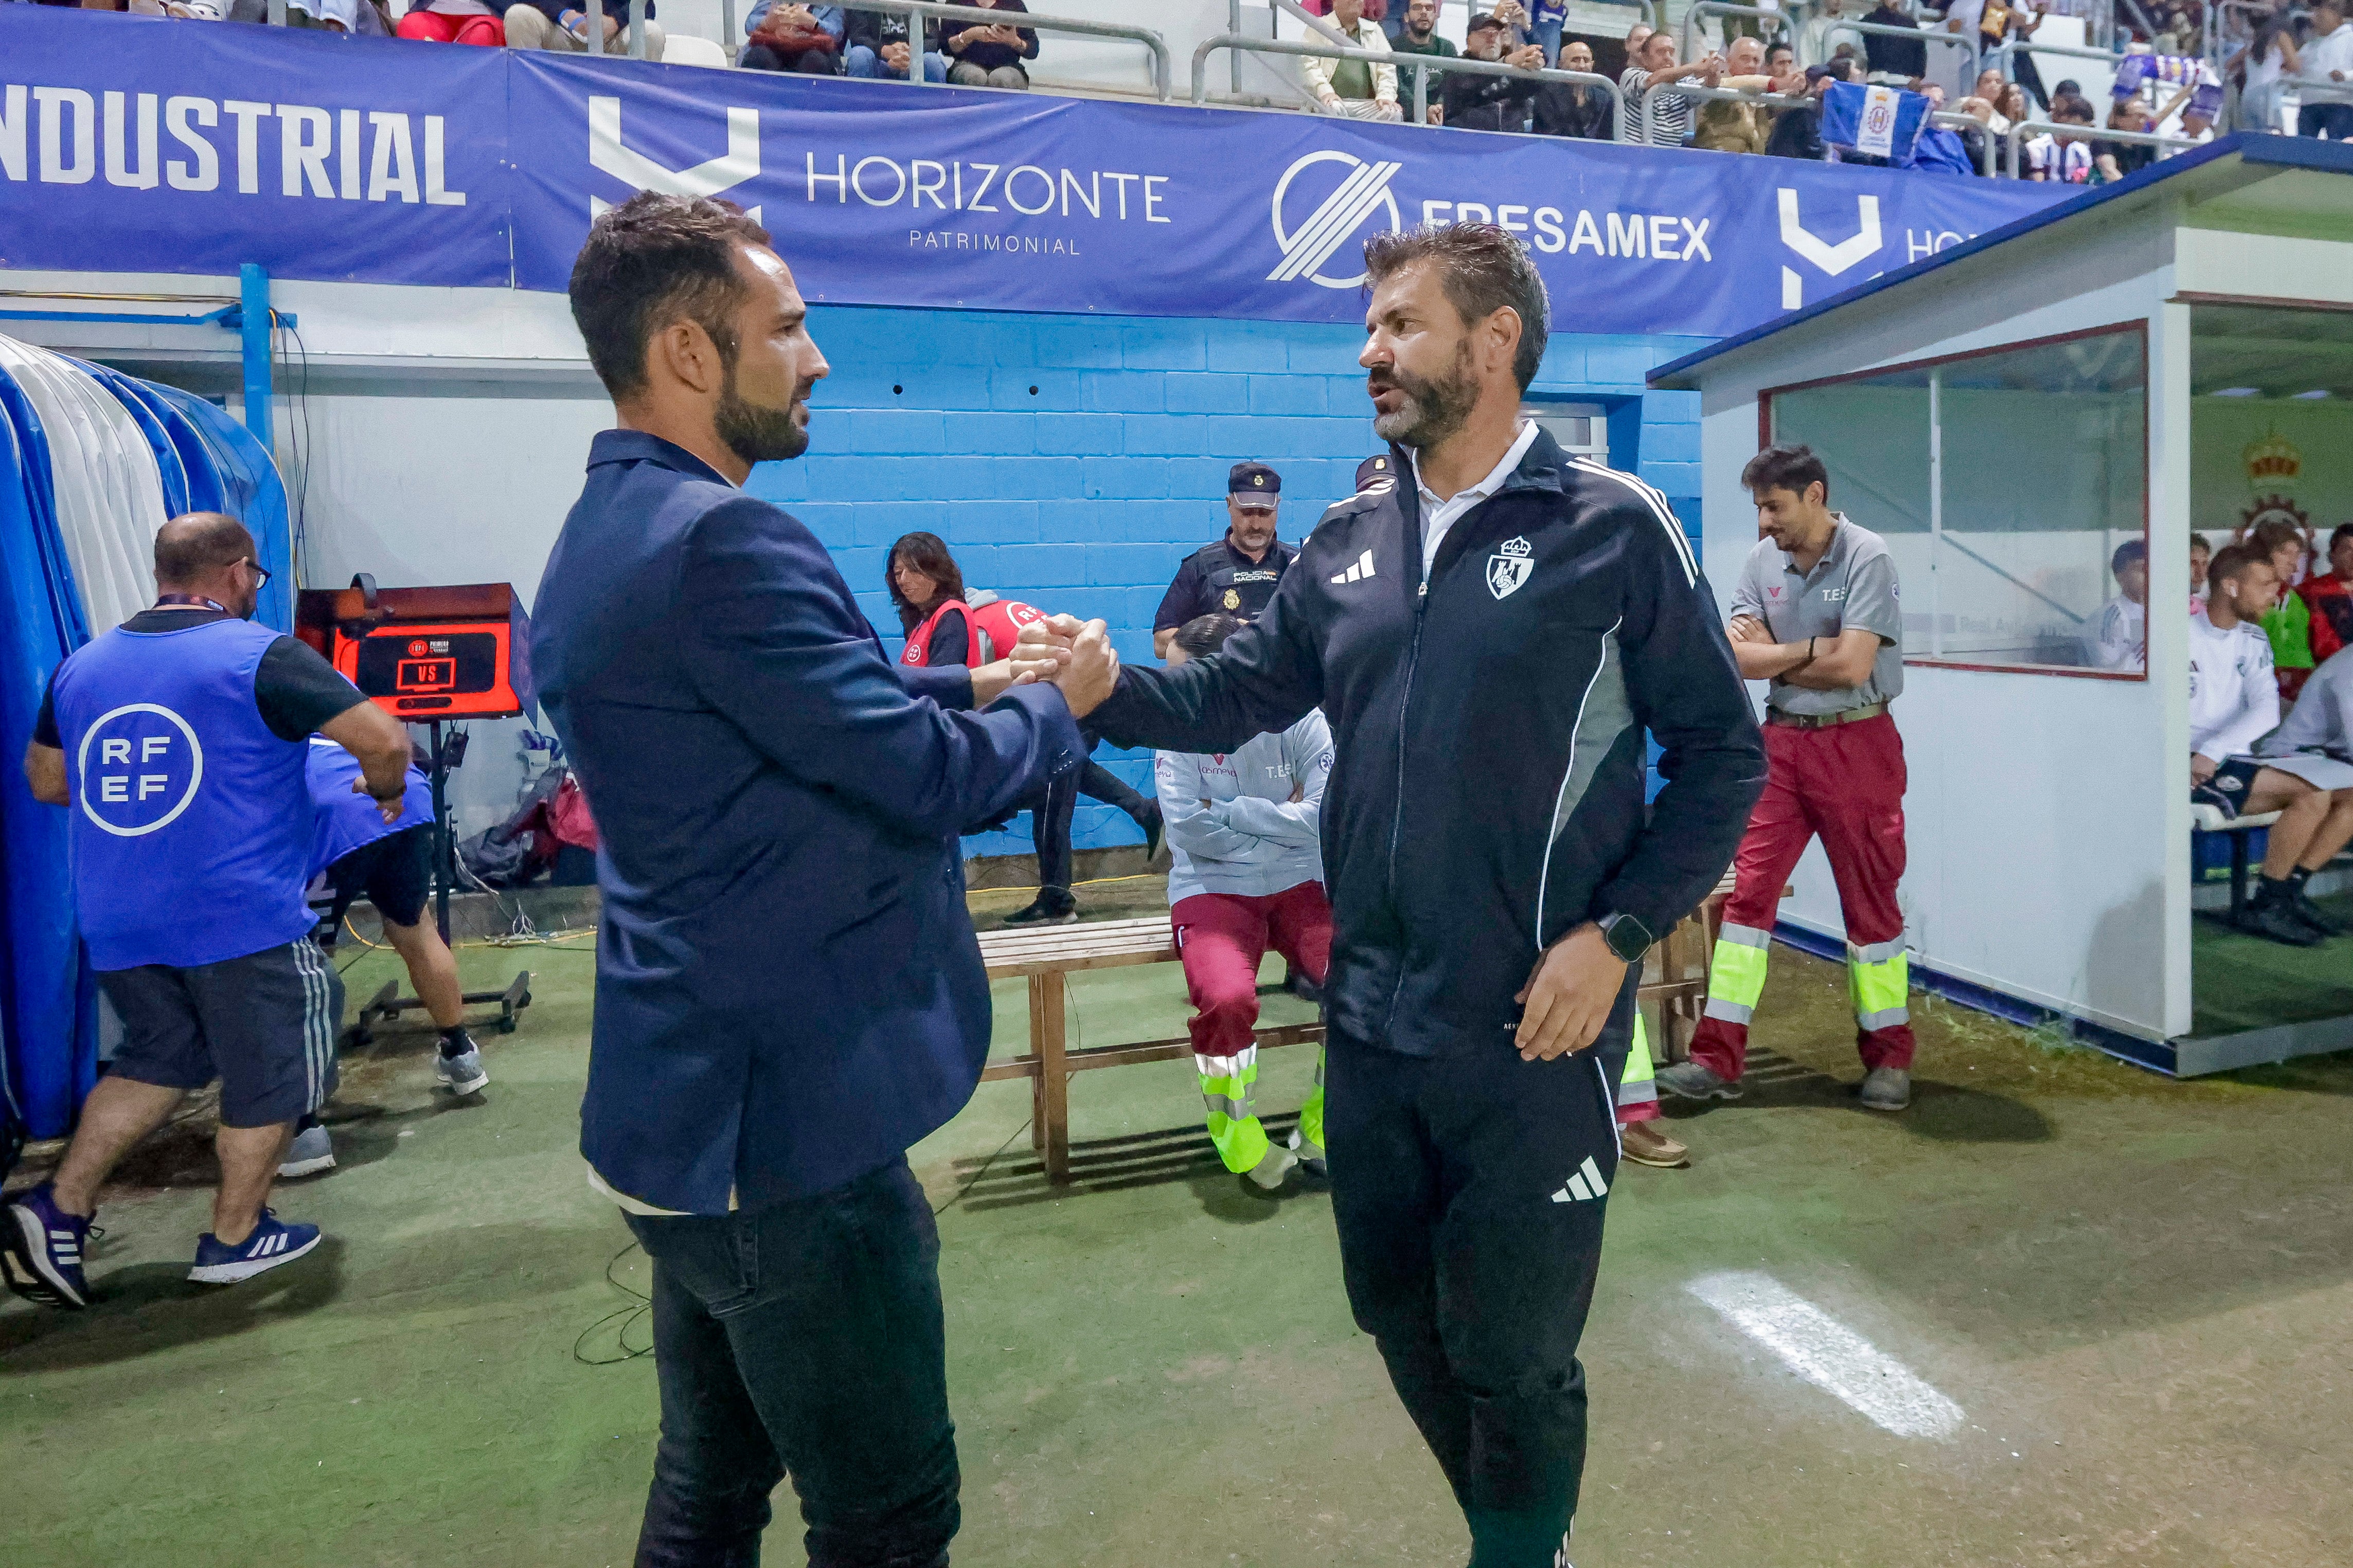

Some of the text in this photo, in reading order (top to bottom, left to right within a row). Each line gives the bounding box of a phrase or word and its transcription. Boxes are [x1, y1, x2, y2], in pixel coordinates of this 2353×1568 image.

[806, 151, 1172, 223] HORIZONTE
[910, 230, 1080, 256] PATRIMONIAL
[1906, 228, 1978, 264] HO
[418, 664, 437, 682] VS
[102, 736, 170, 764] RF
[101, 774, 168, 802] EF
